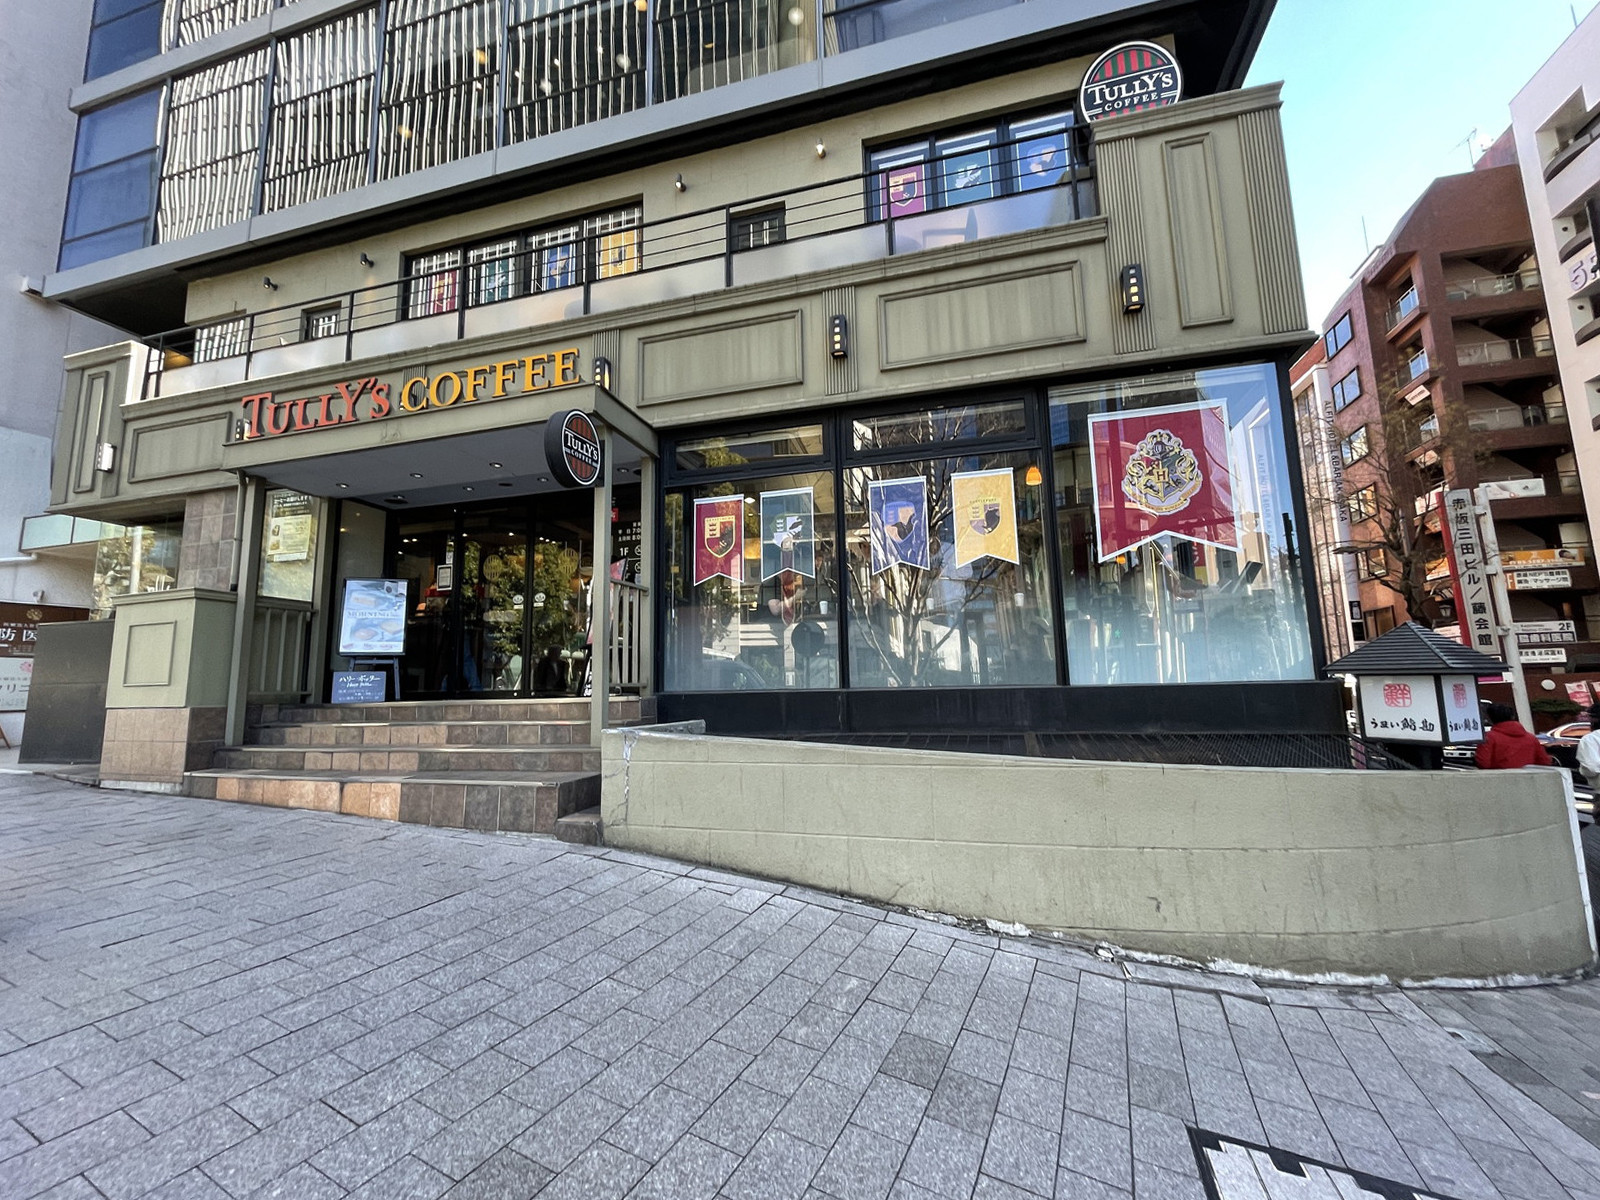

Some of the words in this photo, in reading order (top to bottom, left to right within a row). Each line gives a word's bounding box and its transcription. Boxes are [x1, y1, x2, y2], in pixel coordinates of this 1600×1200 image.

[1087, 72, 1174, 105] TULLY'S
[1104, 92, 1159, 112] COFFEE
[242, 377, 391, 439] TULLY'S
[401, 348, 581, 413] COFFEE
[565, 430, 598, 461] TULLY'S
[571, 448, 592, 464] COFFEE
[1558, 622, 1572, 631] 2F
